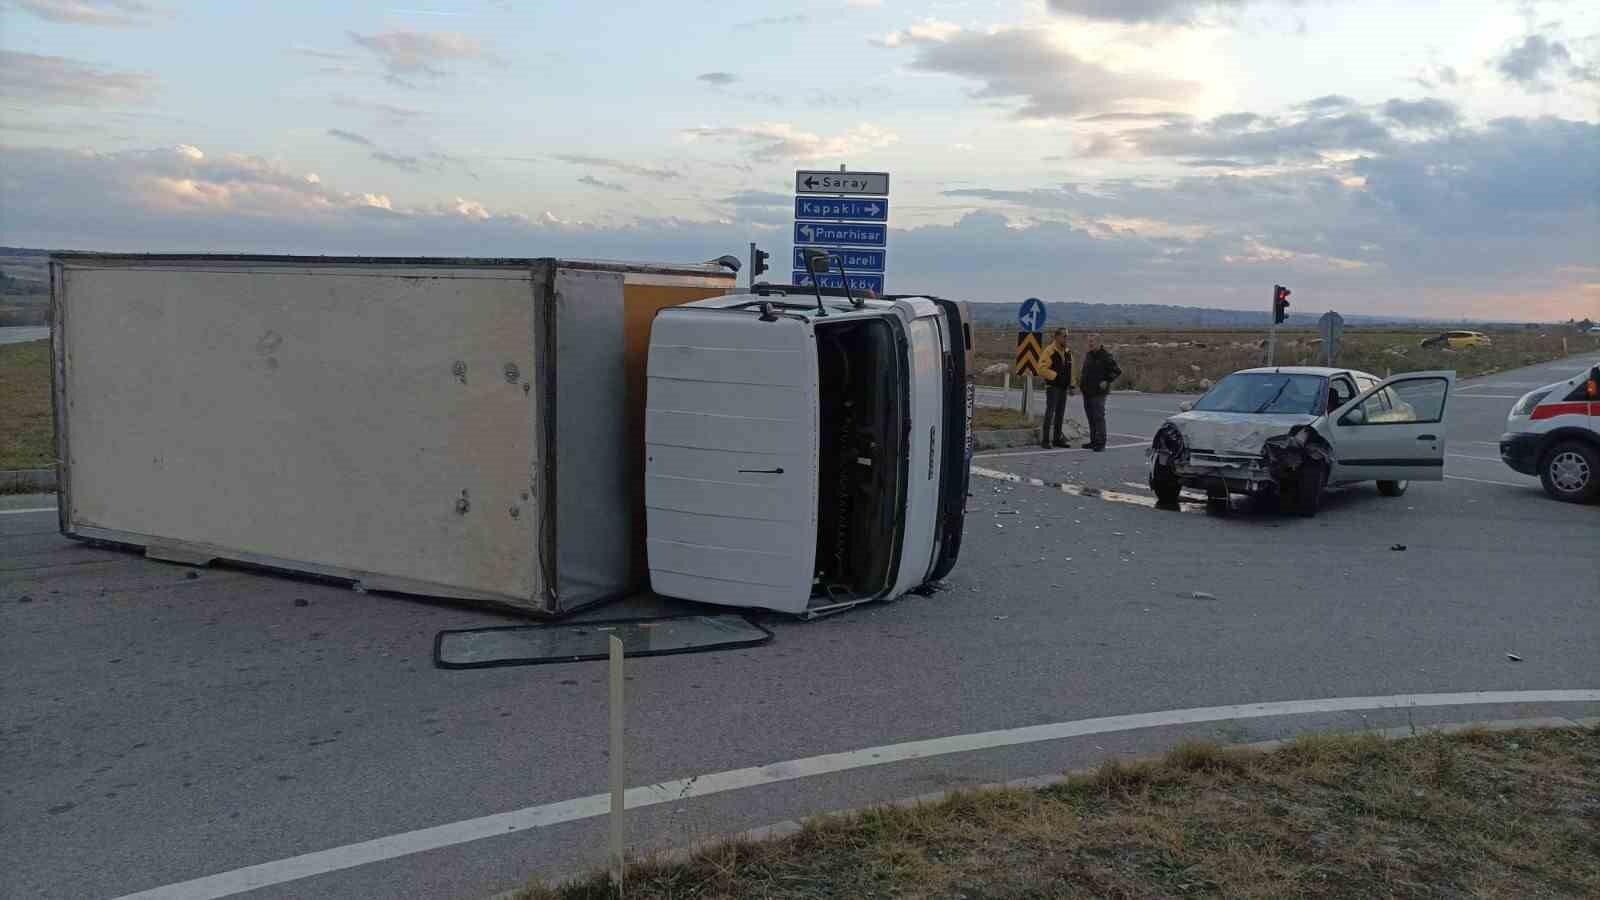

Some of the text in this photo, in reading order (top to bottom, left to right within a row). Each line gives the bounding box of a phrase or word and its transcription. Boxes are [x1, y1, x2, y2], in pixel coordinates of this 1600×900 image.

[823, 176, 868, 191] Saray
[803, 202, 860, 217] Kapaklı
[815, 227, 881, 241] Pınarhisar
